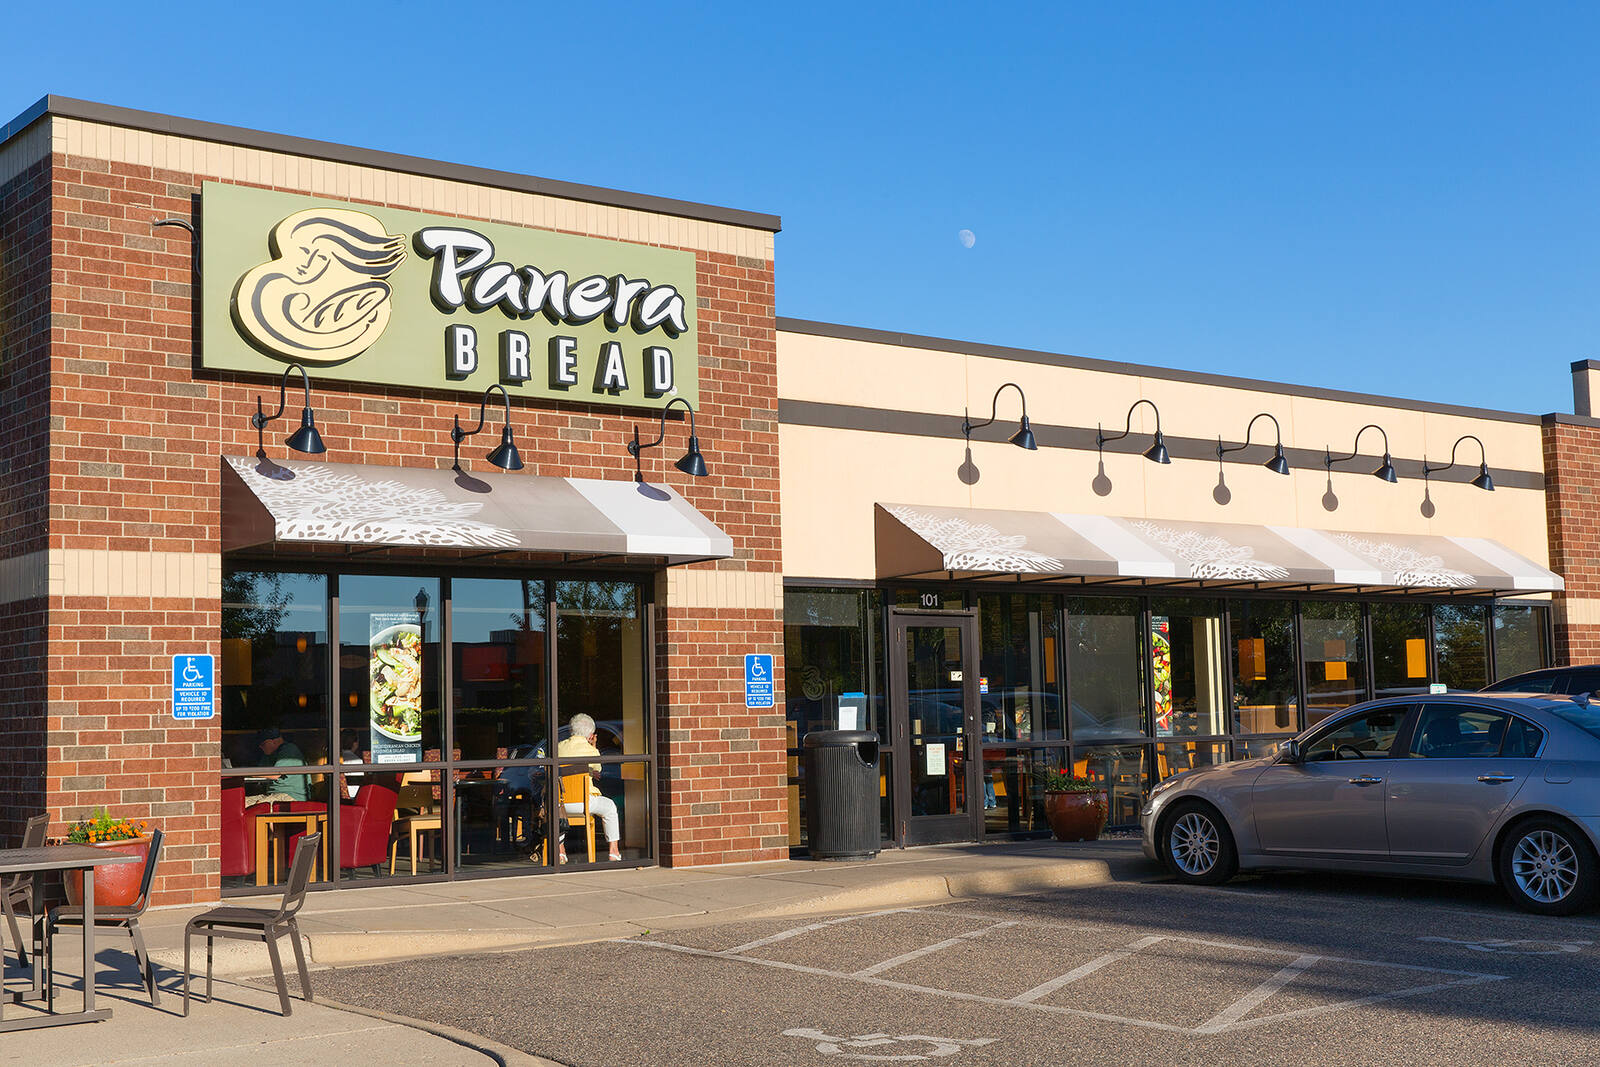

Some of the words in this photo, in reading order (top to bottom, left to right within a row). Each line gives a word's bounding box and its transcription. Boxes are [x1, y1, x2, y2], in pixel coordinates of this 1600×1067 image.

[413, 227, 688, 338] Panera
[446, 323, 674, 397] BREAD
[920, 594, 938, 606] 101
